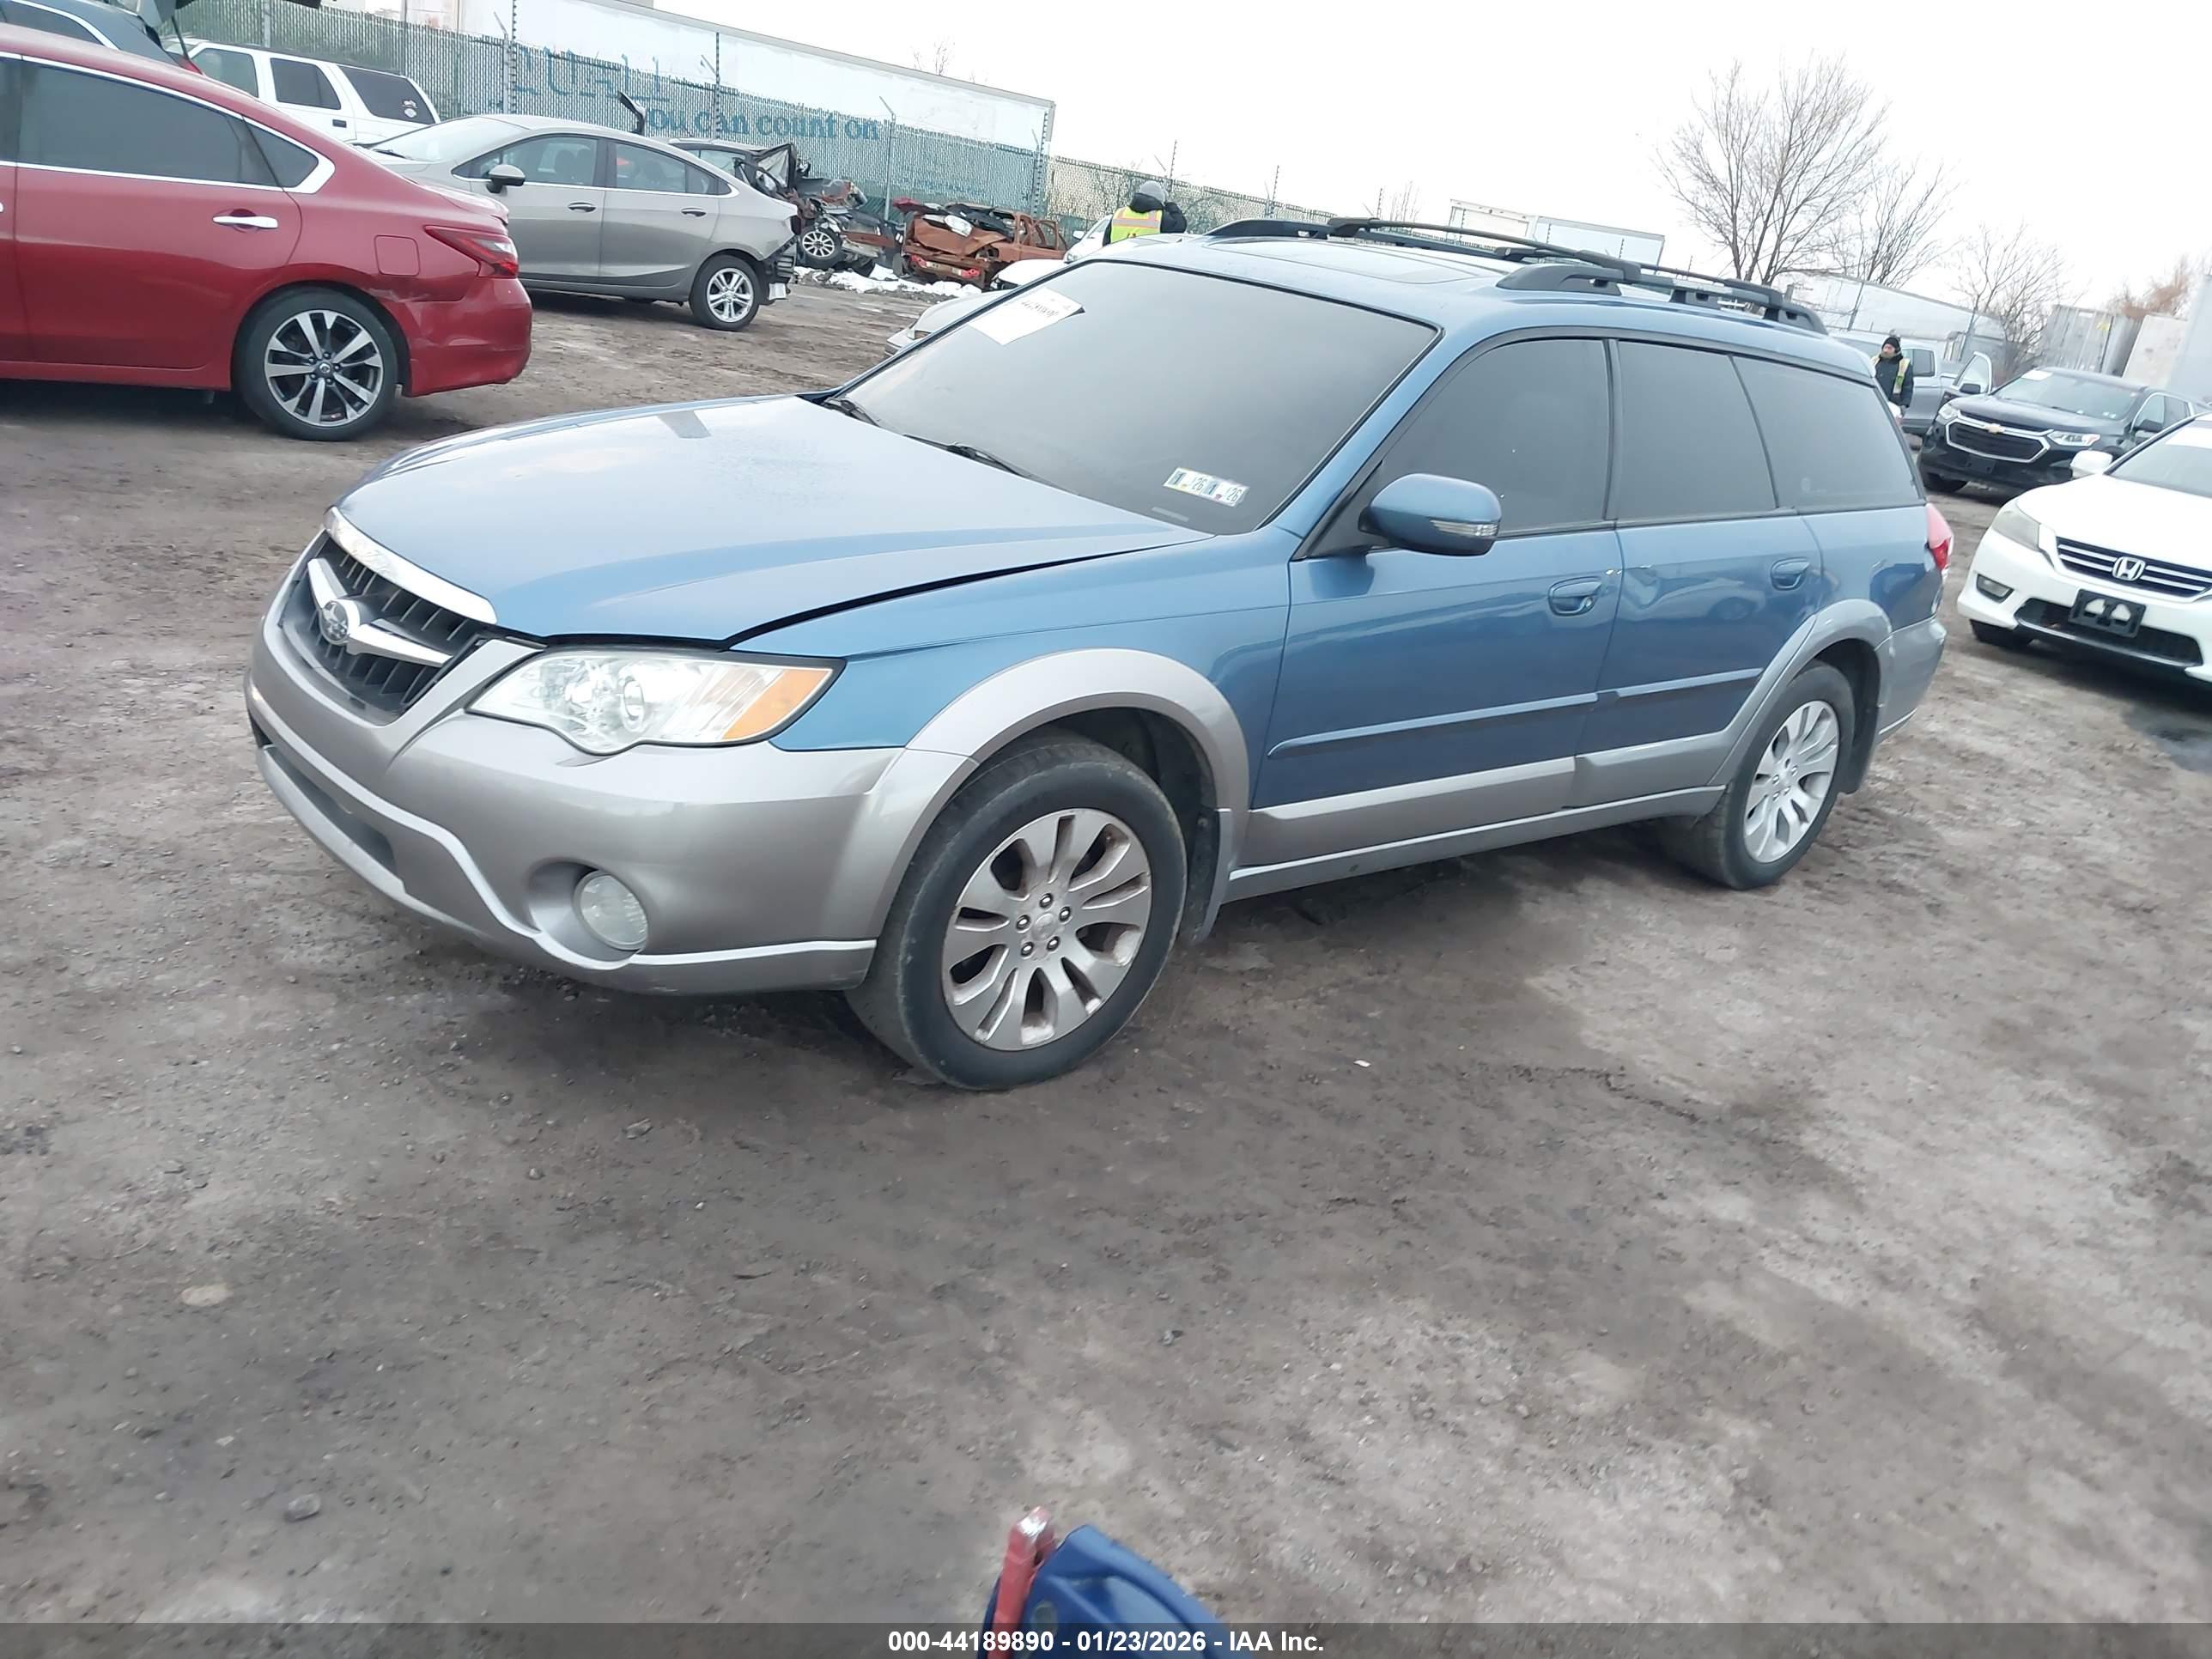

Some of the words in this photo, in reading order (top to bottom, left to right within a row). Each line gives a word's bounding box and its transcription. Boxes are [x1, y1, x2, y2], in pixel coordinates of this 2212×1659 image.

[646, 108, 687, 131] ou
[694, 111, 750, 136] can
[756, 112, 837, 138] count
[844, 119, 879, 140] on
